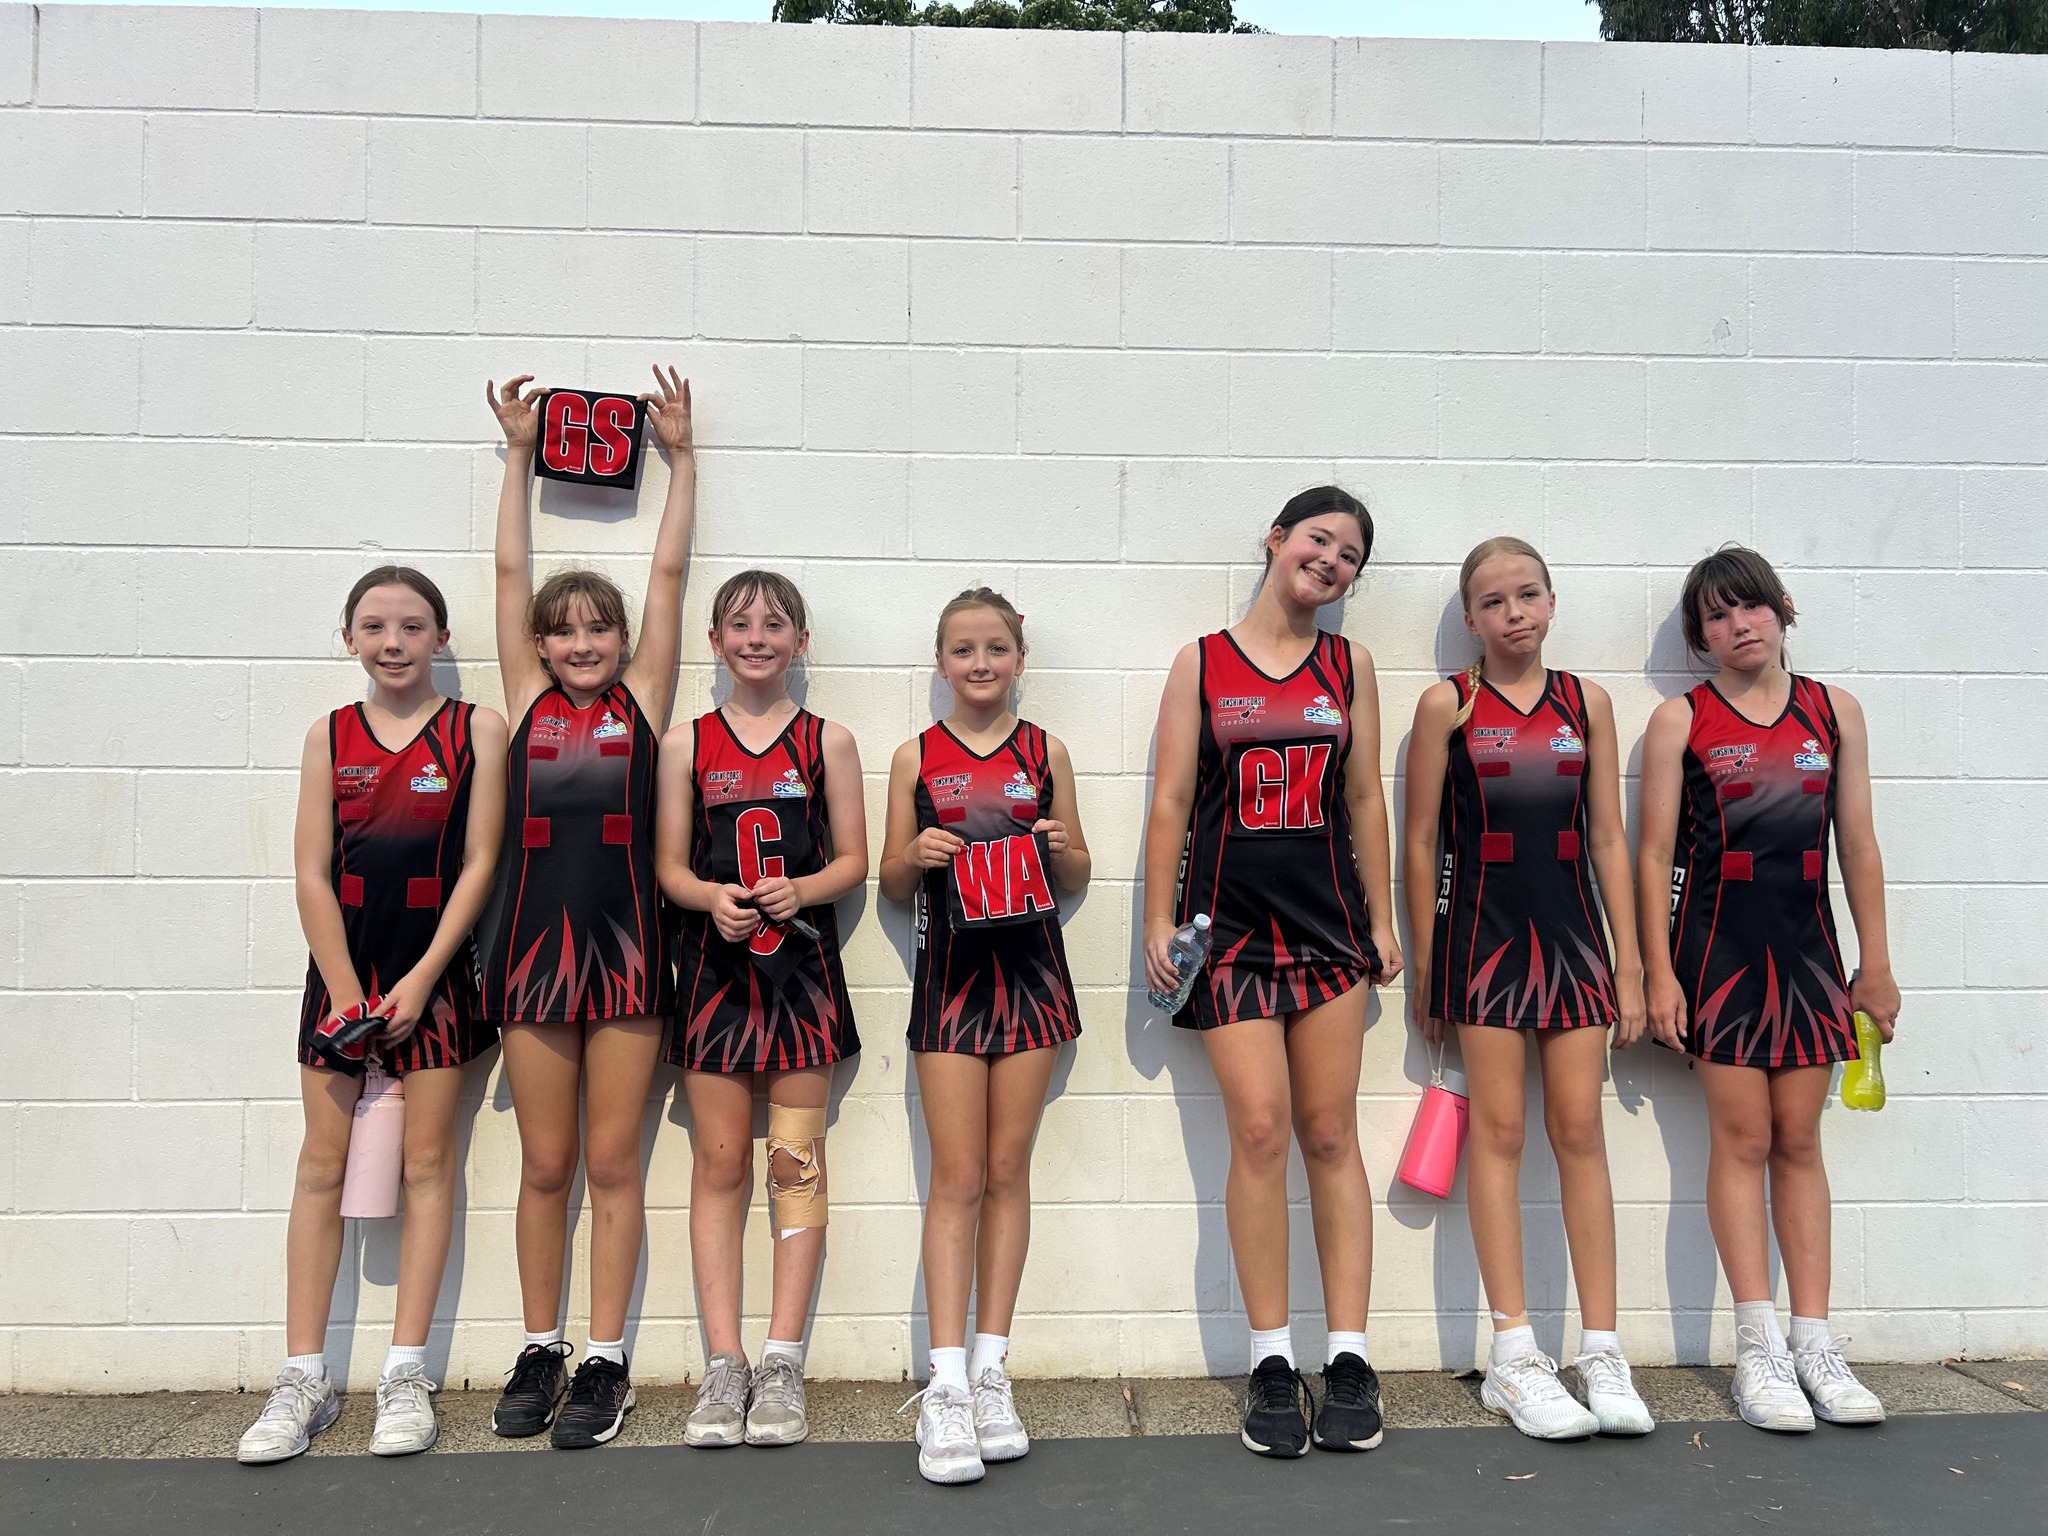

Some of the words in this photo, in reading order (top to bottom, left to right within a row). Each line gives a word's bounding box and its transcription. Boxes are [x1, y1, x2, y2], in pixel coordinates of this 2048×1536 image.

[543, 392, 635, 475] GS
[1239, 744, 1331, 829] GK
[736, 807, 784, 892] C
[954, 834, 1055, 921] WA
[1436, 853, 1453, 915] FIRE
